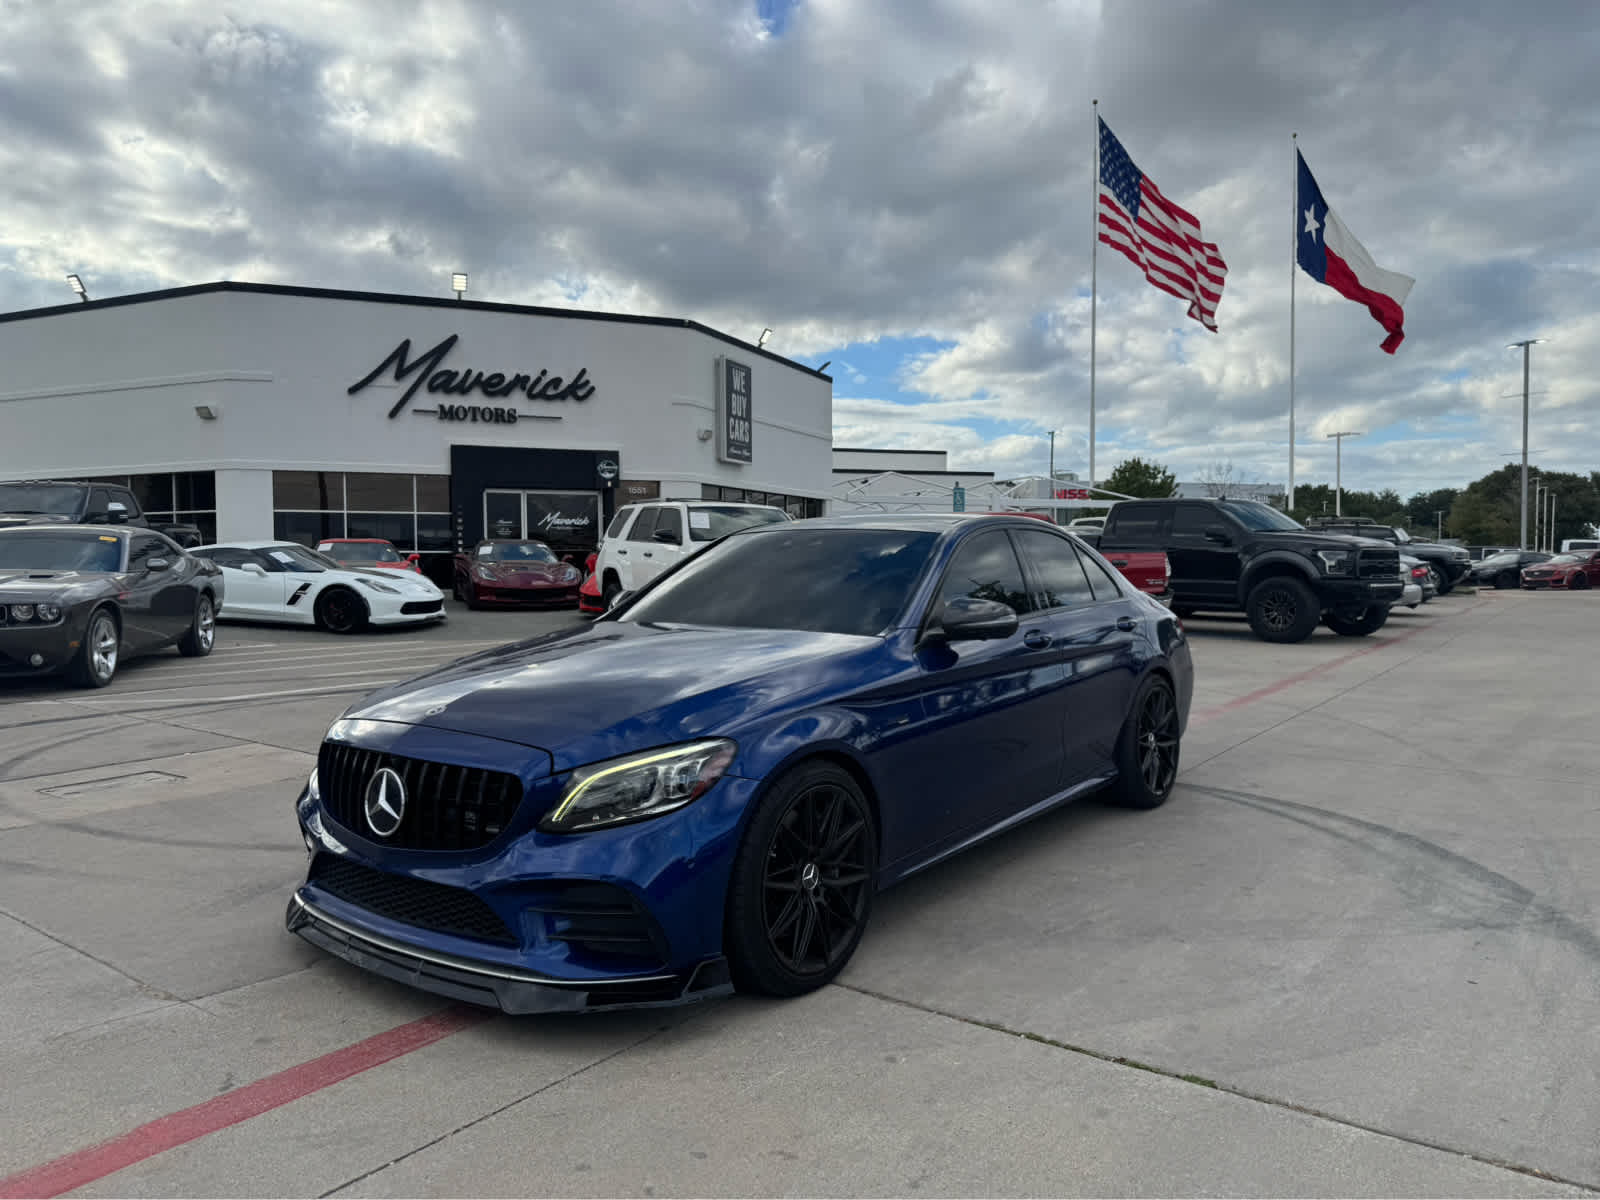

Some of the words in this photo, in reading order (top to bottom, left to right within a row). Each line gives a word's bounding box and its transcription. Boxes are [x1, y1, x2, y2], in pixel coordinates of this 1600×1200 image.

[347, 333, 596, 420] Maverick
[732, 367, 746, 392] WE
[438, 404, 518, 424] MOTORS
[731, 393, 747, 418] BUY
[729, 417, 750, 443] CARS
[1053, 488, 1089, 500] NISS
[537, 511, 590, 531] Maverick
